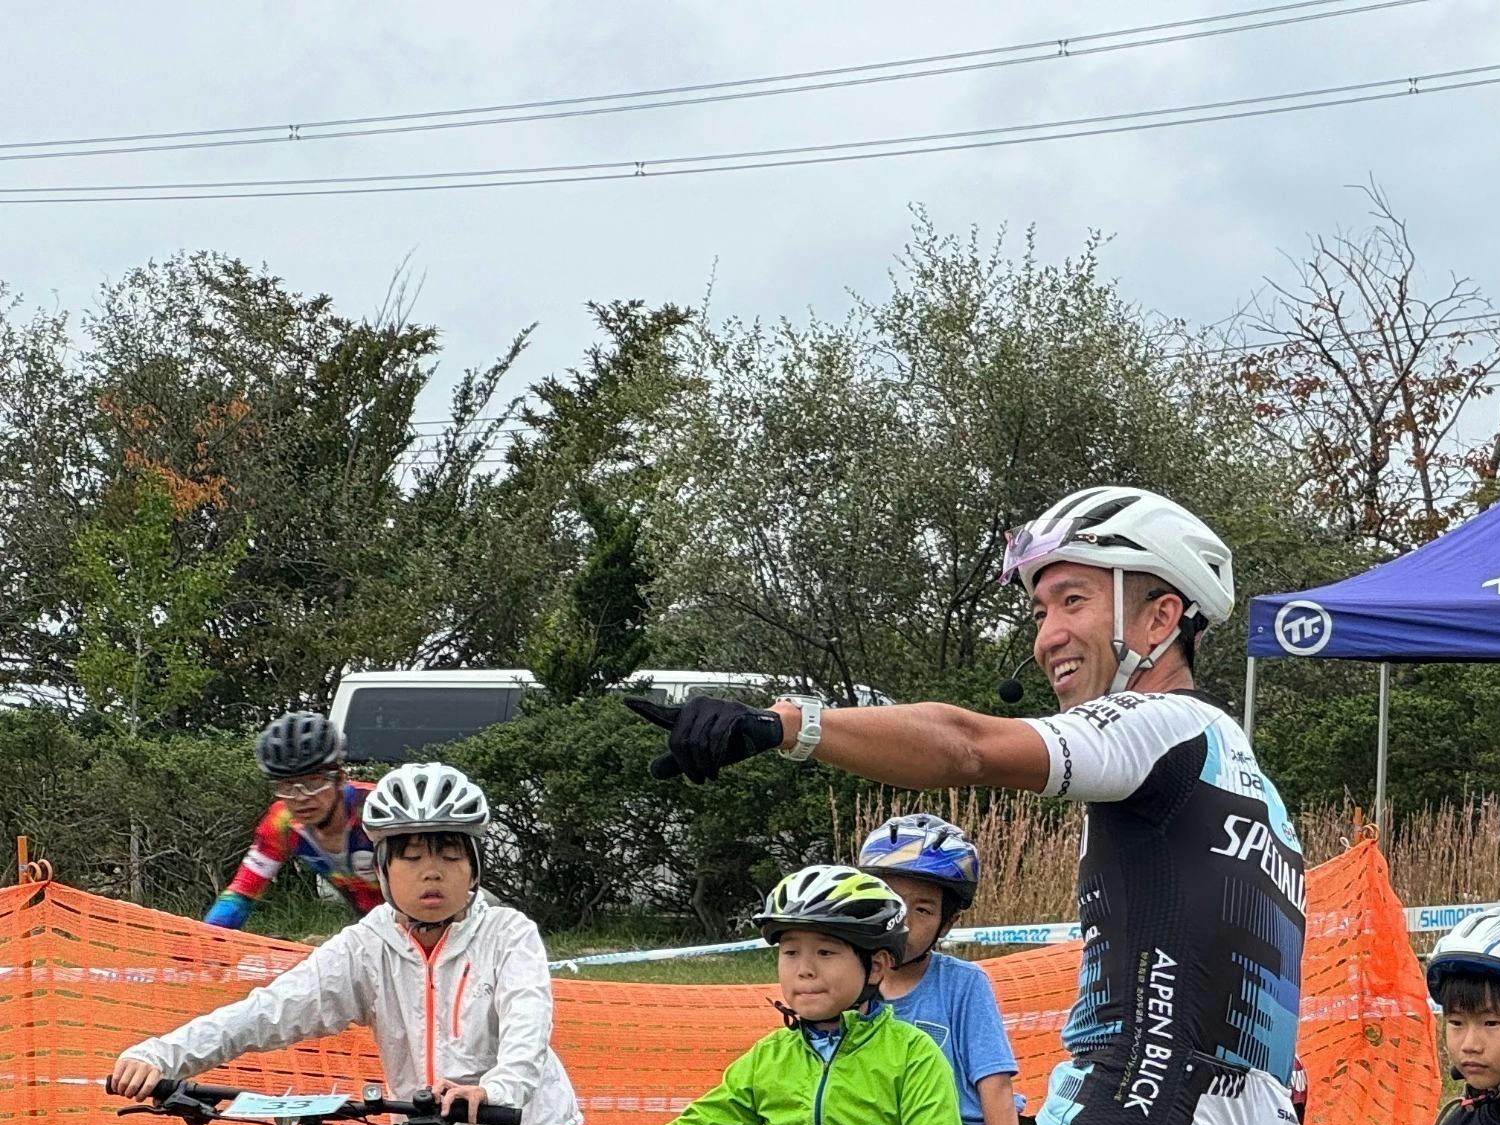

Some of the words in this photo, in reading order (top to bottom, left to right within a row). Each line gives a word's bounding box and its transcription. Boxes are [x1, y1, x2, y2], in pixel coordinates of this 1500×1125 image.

[1148, 947, 1178, 1040] ALPEN
[262, 1100, 313, 1111] 33
[1123, 1042, 1173, 1118] BLICK
